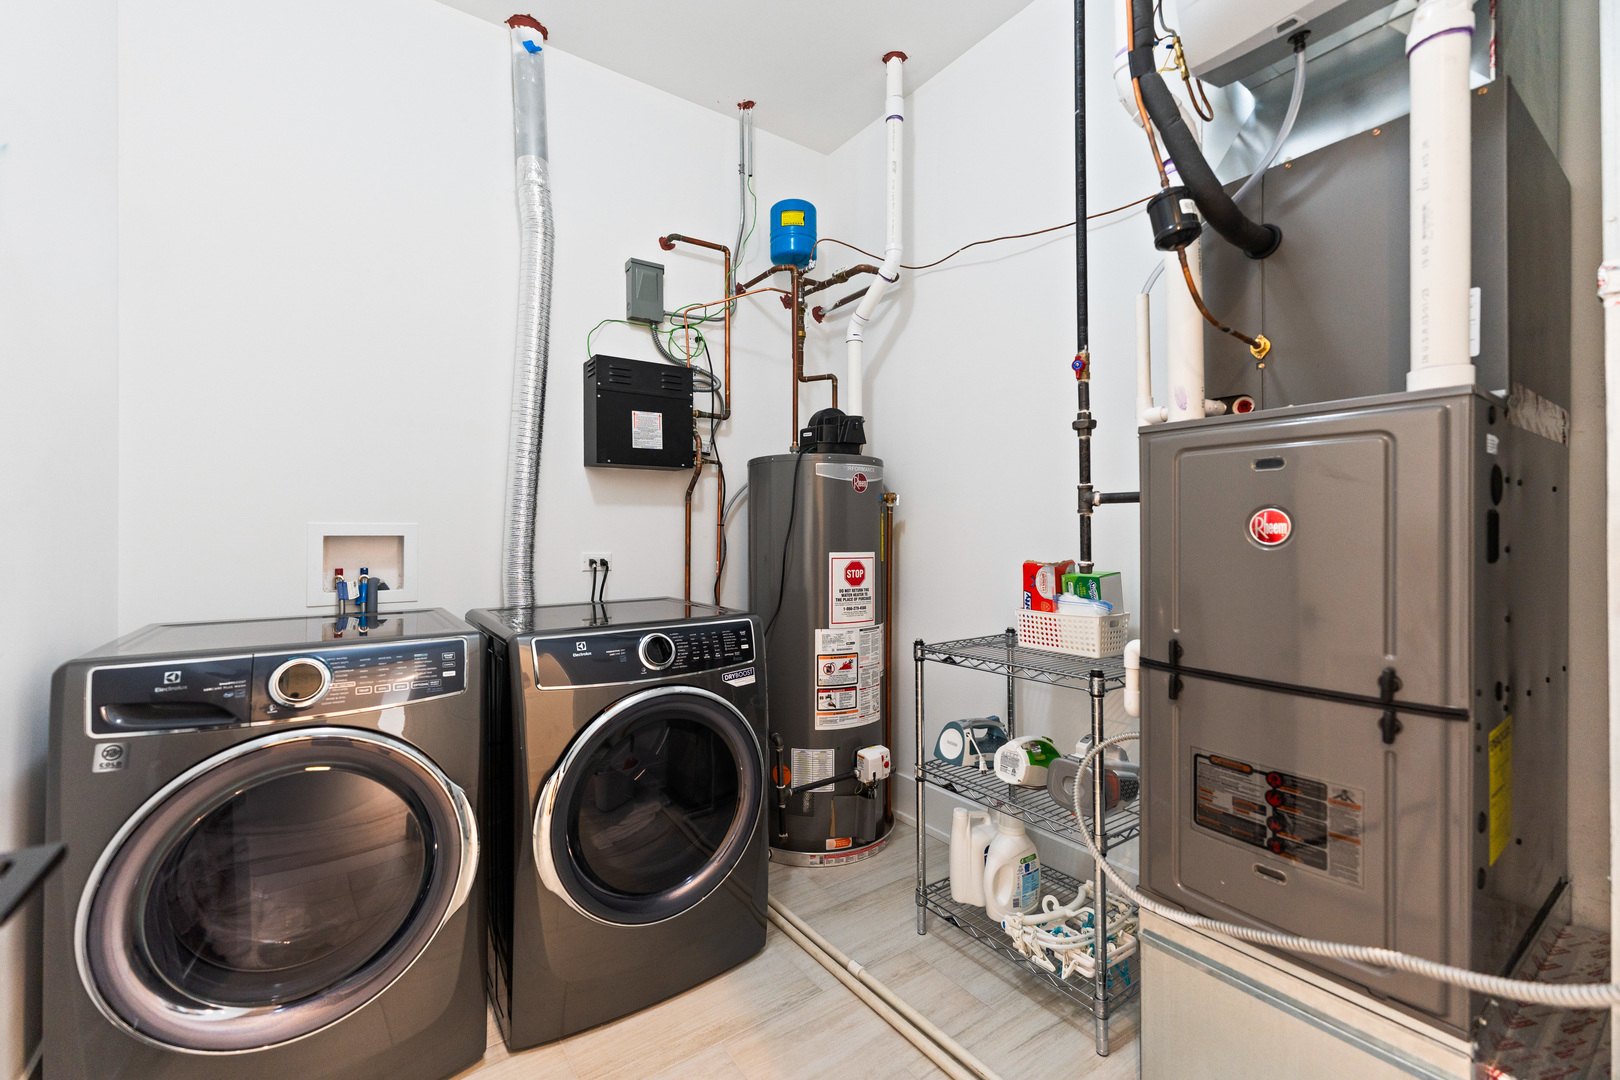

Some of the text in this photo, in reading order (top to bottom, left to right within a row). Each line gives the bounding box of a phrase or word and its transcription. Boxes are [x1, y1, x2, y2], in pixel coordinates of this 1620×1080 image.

[1254, 512, 1288, 539] Rheem
[846, 569, 864, 578] STOP
[724, 668, 753, 681] DRYBOOST
[154, 685, 188, 693] Electrolux
